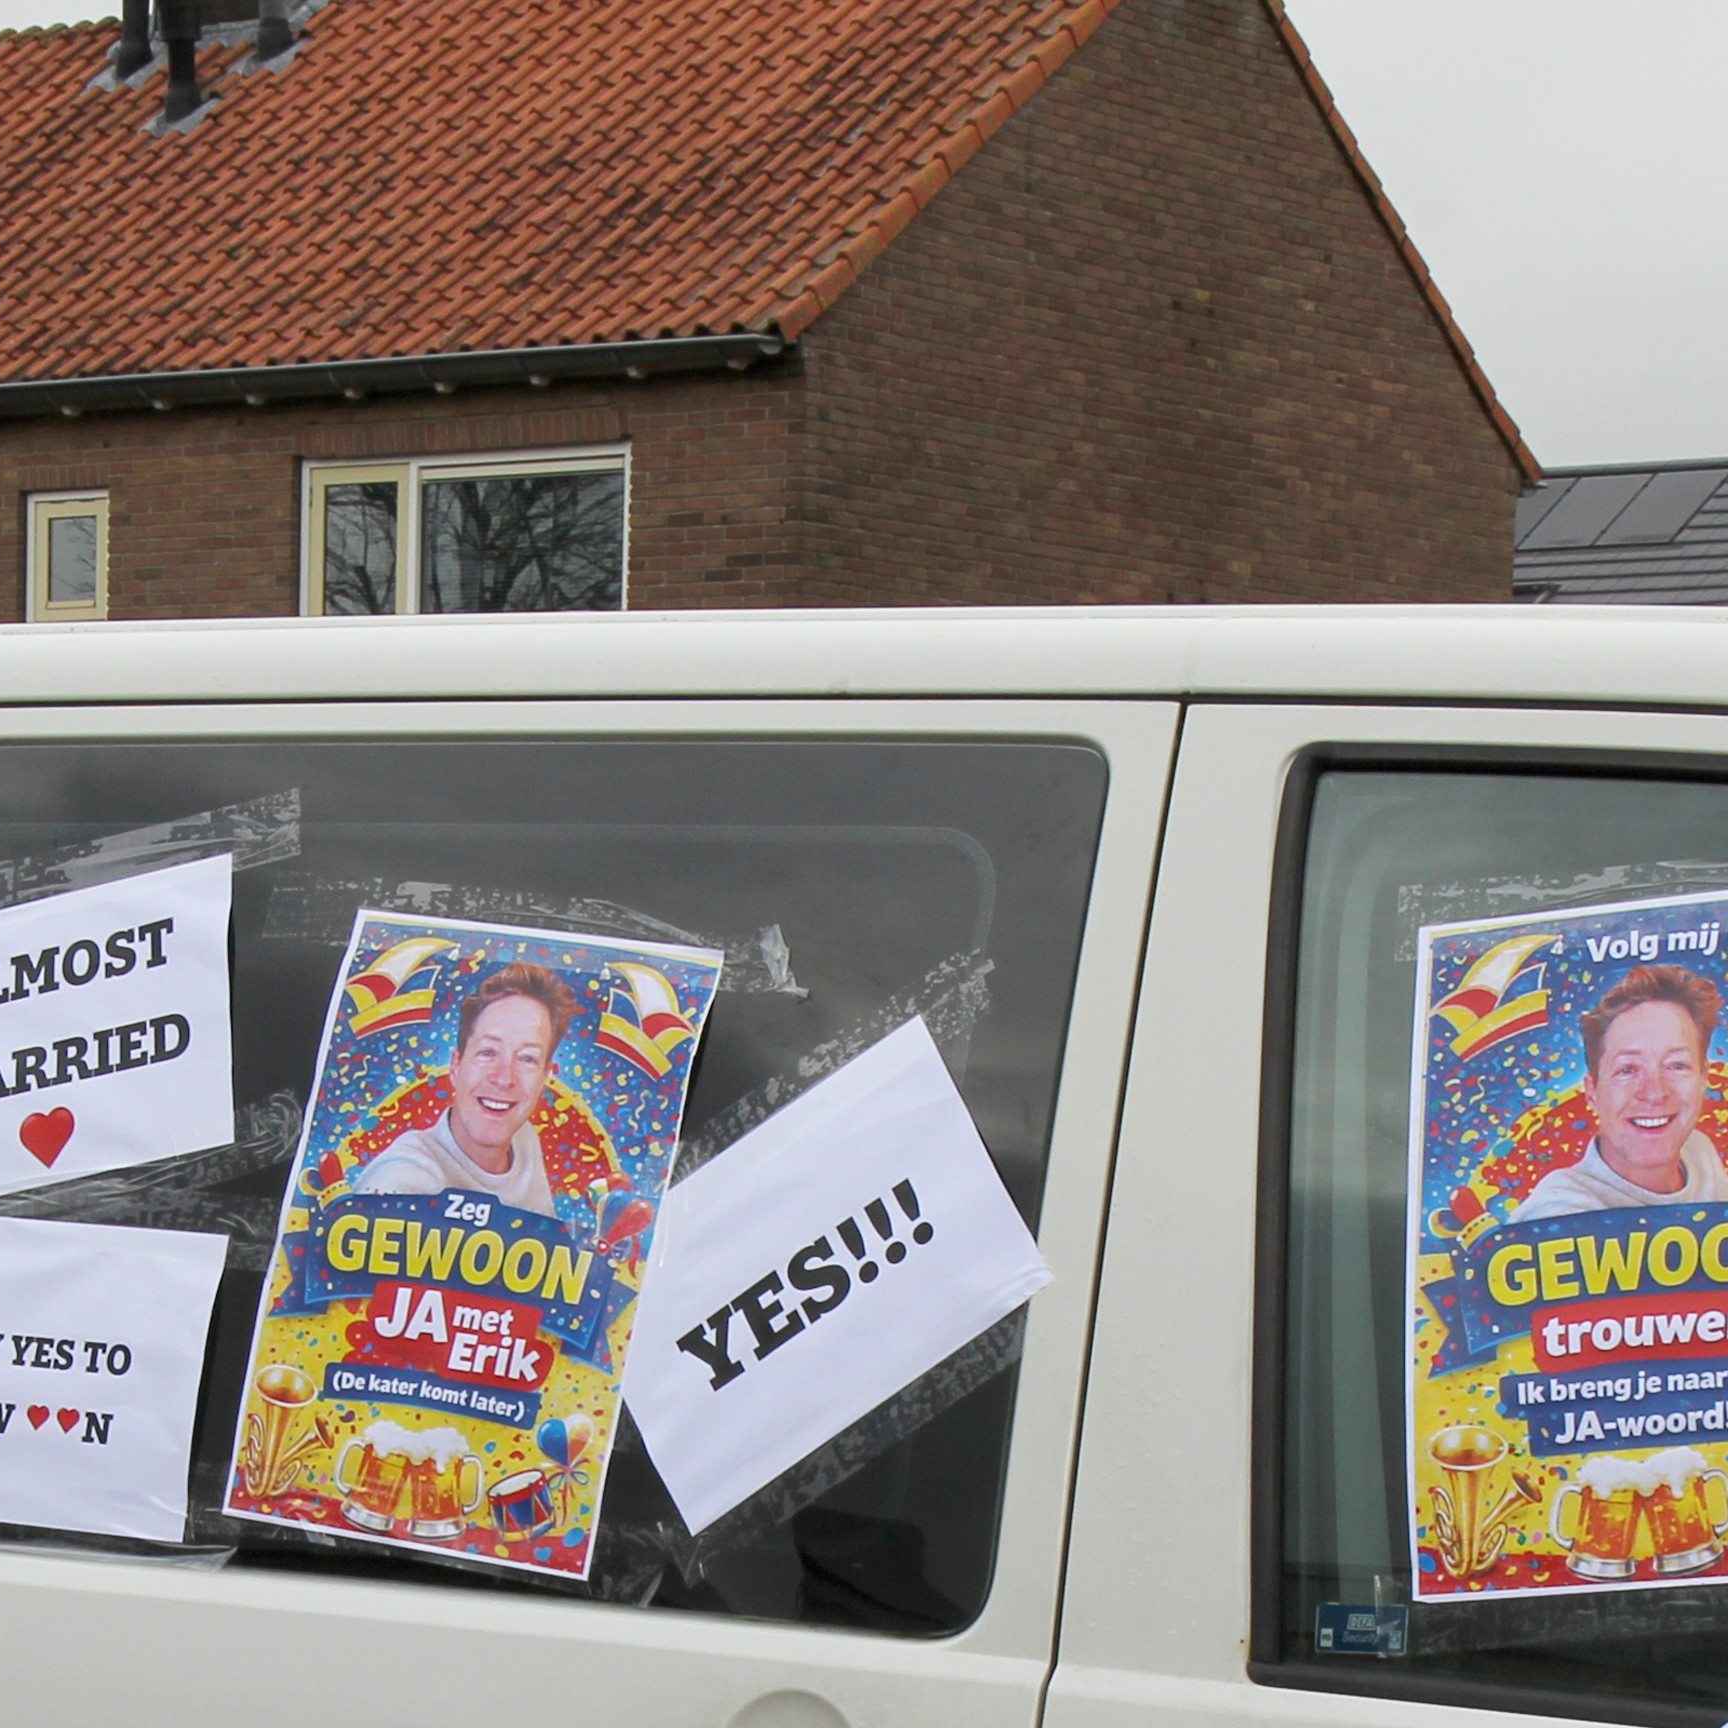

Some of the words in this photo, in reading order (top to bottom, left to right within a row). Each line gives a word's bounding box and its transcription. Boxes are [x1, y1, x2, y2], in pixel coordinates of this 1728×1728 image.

[1586, 930, 1659, 962] Volg
[1667, 922, 1720, 956] mij
[444, 1193, 491, 1227] Zeg
[326, 1213, 594, 1305] GEWOON
[676, 1178, 934, 1392] YES!!!
[374, 1287, 448, 1343] JA
[452, 1305, 514, 1335] met
[11, 1334, 76, 1371] YES
[83, 1341, 132, 1376] TO
[447, 1332, 541, 1382] Erik
[332, 1370, 365, 1391] (De
[368, 1374, 418, 1398] kater
[421, 1381, 467, 1406] komt
[471, 1391, 525, 1422] later)
[1517, 1383, 1545, 1405] Ik
[1550, 1378, 1632, 1401] breng
[1634, 1371, 1662, 1400] je
[1667, 1370, 1728, 1391] naar
